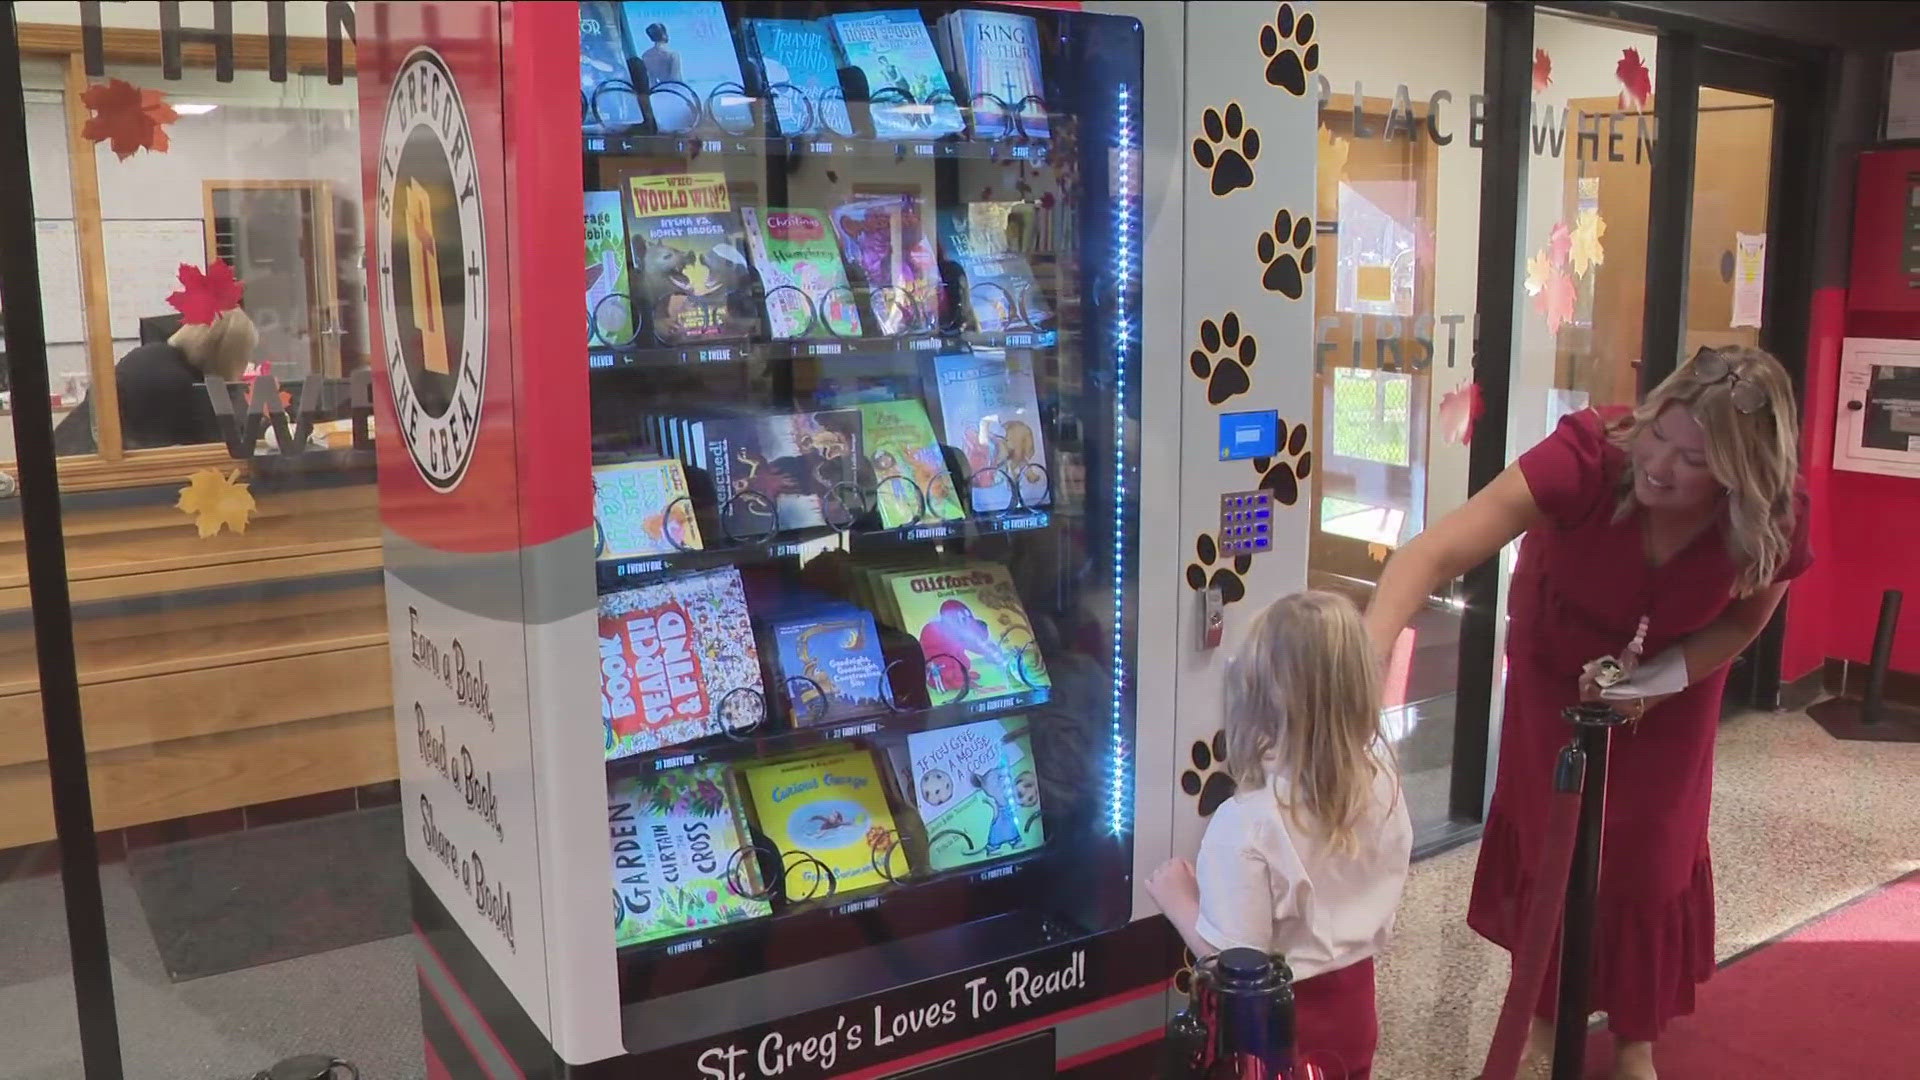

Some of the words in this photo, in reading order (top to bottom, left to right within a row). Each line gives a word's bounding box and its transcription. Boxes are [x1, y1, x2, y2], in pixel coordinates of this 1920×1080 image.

[773, 28, 822, 51] TREASURE
[977, 23, 1025, 44] KING
[778, 51, 828, 72] ISLAND
[397, 65, 475, 209] GREGORY
[708, 140, 721, 152] TWO
[666, 176, 693, 187] WHO
[634, 186, 688, 215] WOULD
[689, 183, 727, 213] WIN?
[650, 227, 683, 239] HONEY
[767, 213, 820, 229] Christmas
[773, 247, 835, 263] Humphrey
[590, 354, 615, 368] ELEVEN
[708, 349, 731, 361] TWELVE
[391, 338, 419, 446] THE
[429, 350, 479, 474] GREAT
[911, 571, 994, 593] Clifford's
[408, 605, 441, 680] Earn
[442, 653, 453, 690] a
[452, 637, 496, 733] Book,
[627, 616, 674, 724] SEARCH
[657, 611, 699, 698] FIND
[600, 633, 636, 718] BOOK
[676, 695, 702, 715] &
[916, 759, 930, 773] IF
[930, 743, 951, 763] YOU
[950, 729, 977, 751] GIVE
[949, 758, 957, 773] A
[956, 735, 991, 763] MOUSE
[415, 701, 449, 780] Read
[451, 757, 462, 793] a
[461, 744, 504, 843] Book,
[824, 773, 869, 791] George
[957, 768, 966, 783] A
[772, 778, 819, 803] Curious
[609, 801, 652, 914] GARDEN
[651, 824, 680, 883] CURTAIN
[683, 821, 717, 874] CROSS
[420, 793, 459, 880] Share
[462, 859, 473, 896] a
[471, 849, 516, 955] Book!
[696, 1042, 748, 1080] St.
[757, 1016, 863, 1070] Greg's
[873, 997, 957, 1047] Loves
[964, 976, 998, 1019] To
[1005, 950, 1087, 1009] Read!
